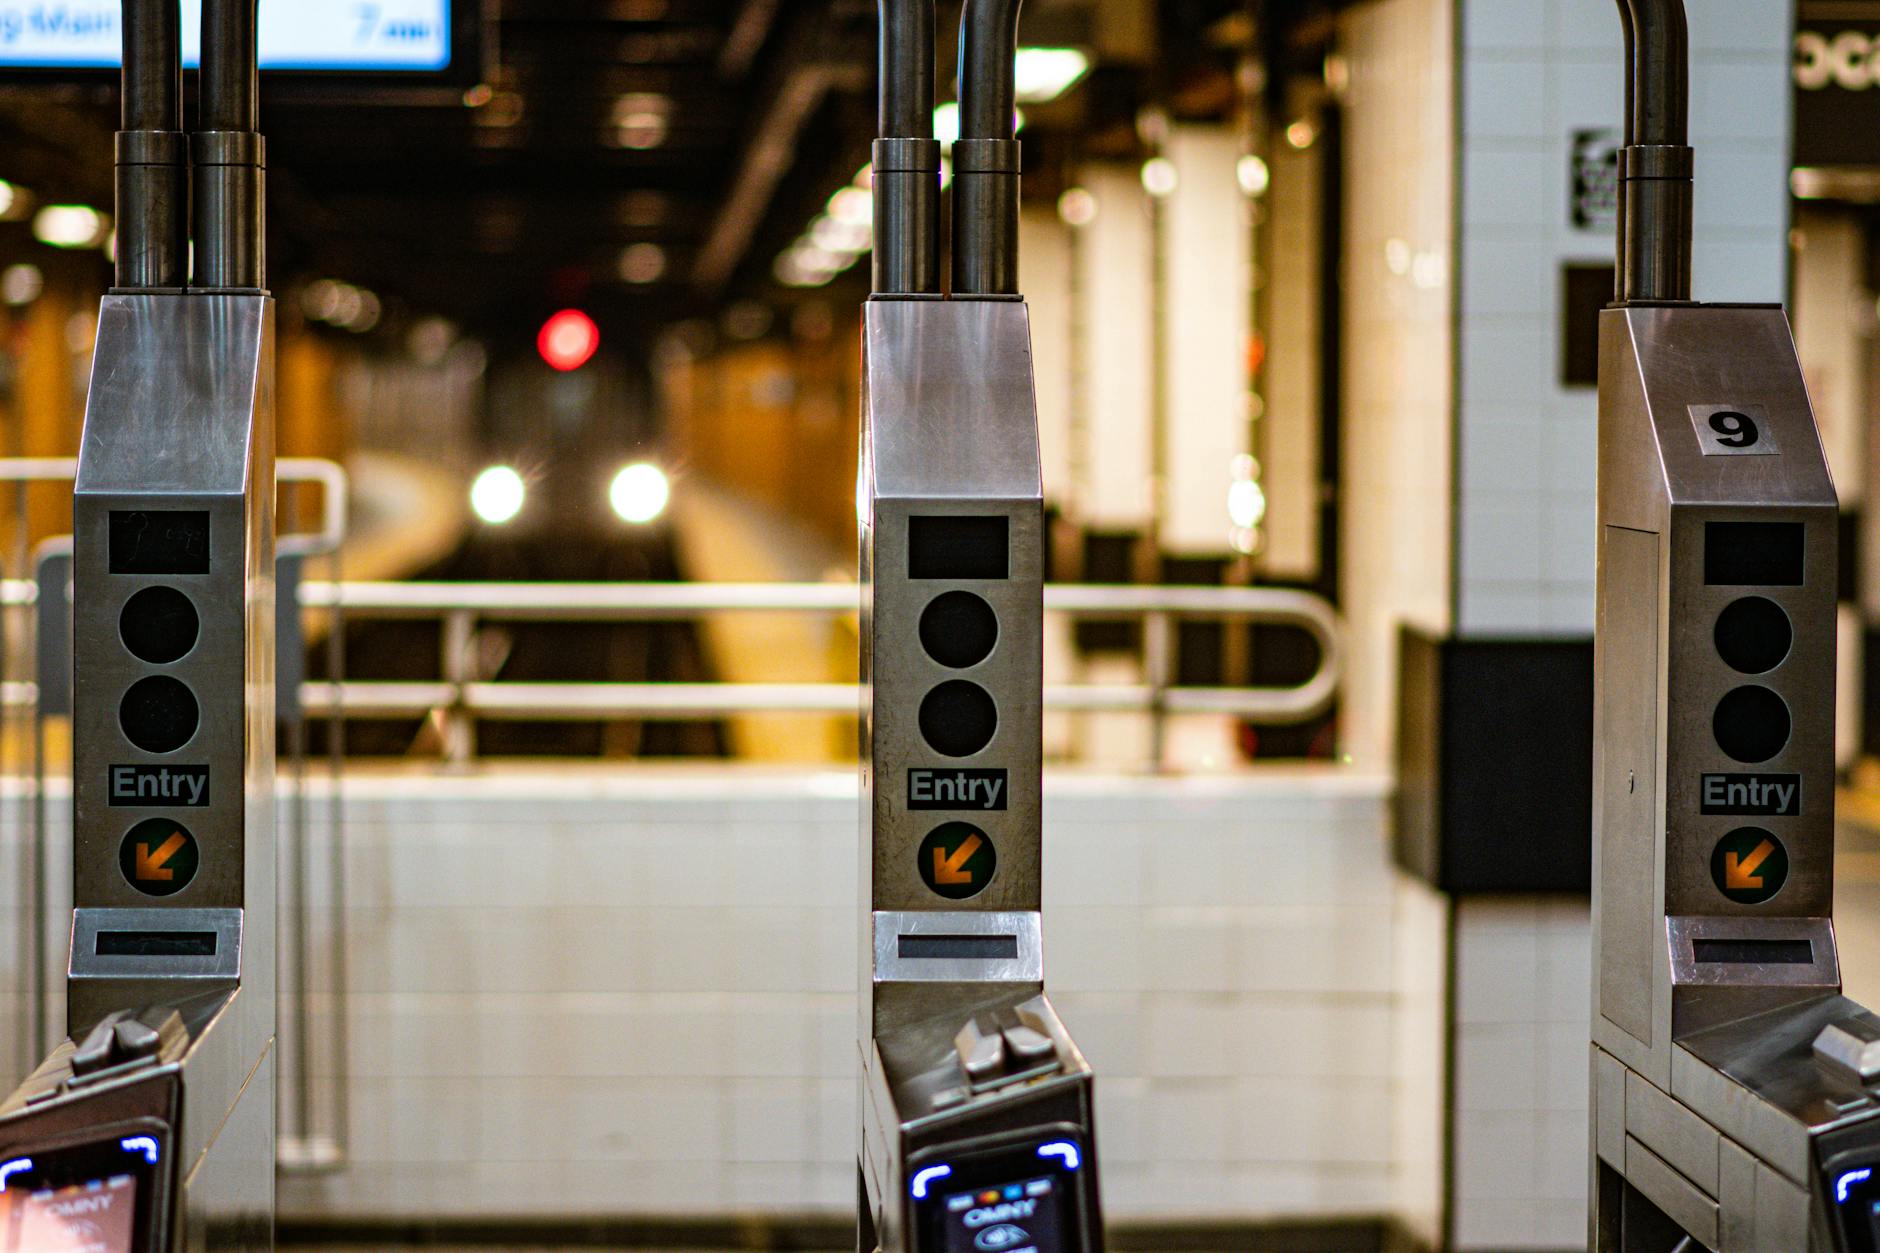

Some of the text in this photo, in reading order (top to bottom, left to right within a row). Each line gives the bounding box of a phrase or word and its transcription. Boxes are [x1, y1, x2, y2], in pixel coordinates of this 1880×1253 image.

[1708, 412, 1758, 447] 9
[113, 767, 207, 805] Entry
[911, 771, 1003, 809] Entry
[1704, 776, 1795, 814] Entry
